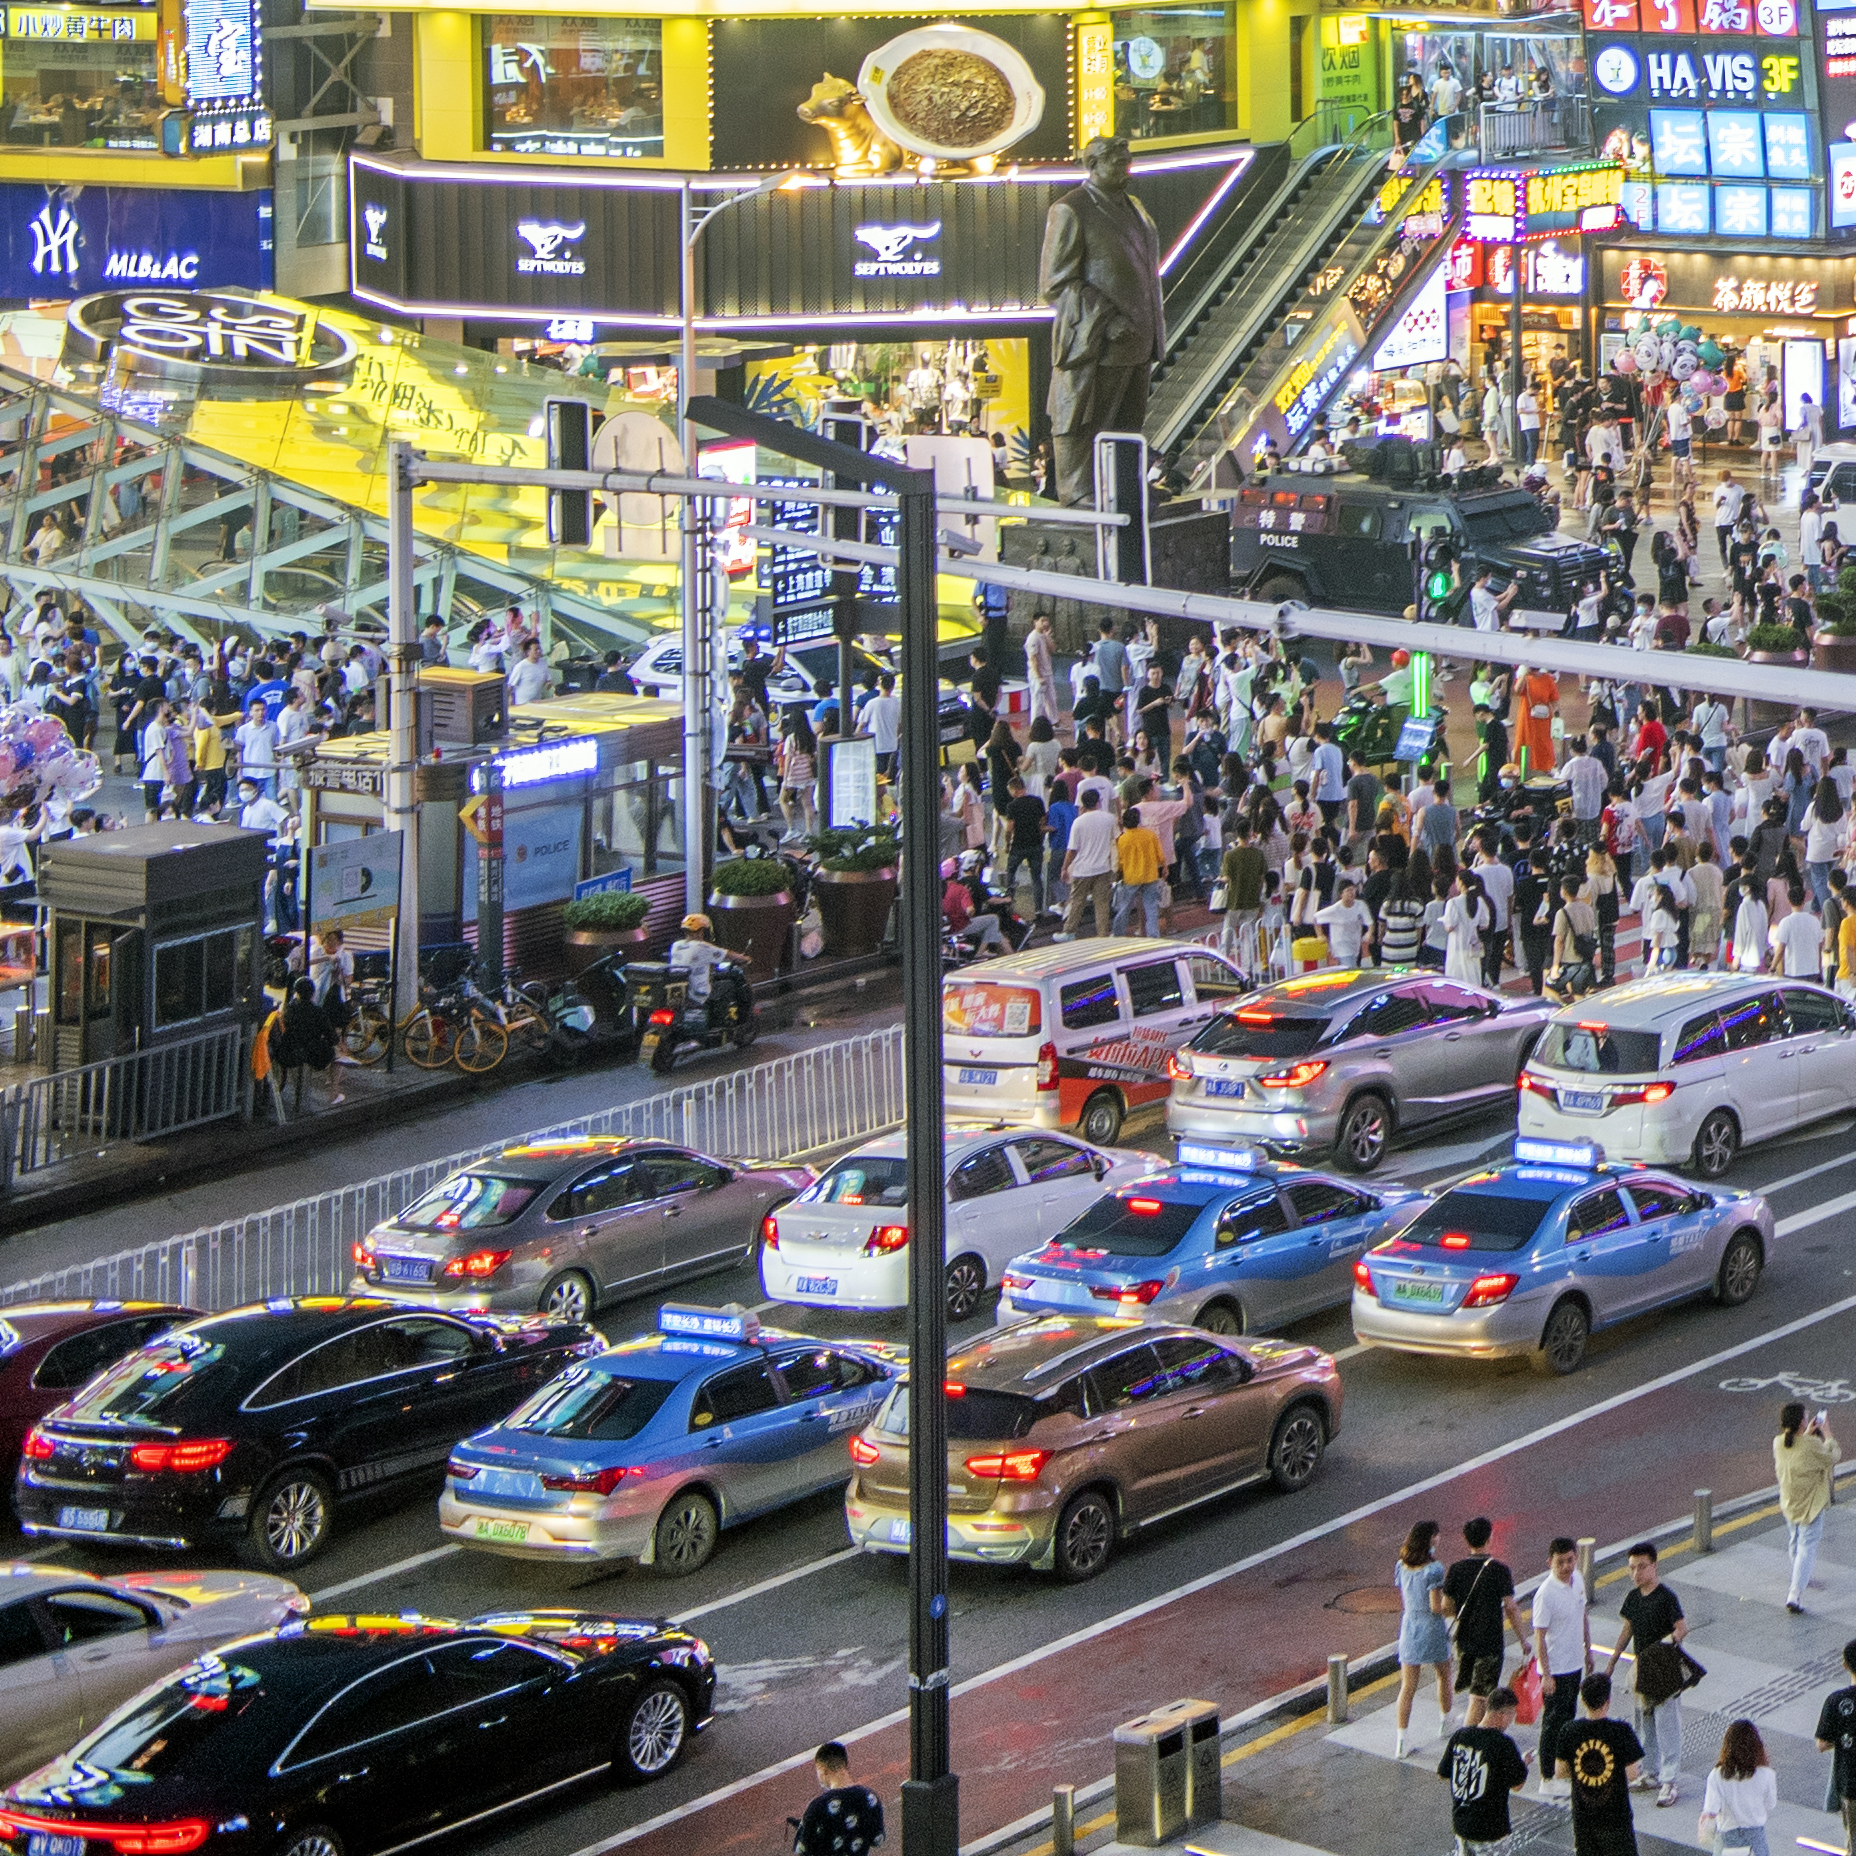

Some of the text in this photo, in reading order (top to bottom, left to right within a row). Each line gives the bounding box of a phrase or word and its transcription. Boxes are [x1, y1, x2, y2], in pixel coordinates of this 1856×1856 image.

[17, 14, 137, 39] 小炒黄牛肉
[1761, 6, 1790, 26] 3F
[1762, 56, 1798, 92] 3F
[1657, 120, 1759, 167] 坛宗
[1665, 188, 1761, 231] 坛宗
[518, 258, 586, 275] SEPTWOLVES
[854, 259, 941, 276] SEPTWOLVES
[1713, 277, 1818, 315] 茶颜悦色
[1259, 509, 1306, 532] 特警
[1260, 534, 1299, 548] POLICE
[534, 839, 571, 857] POLICE
